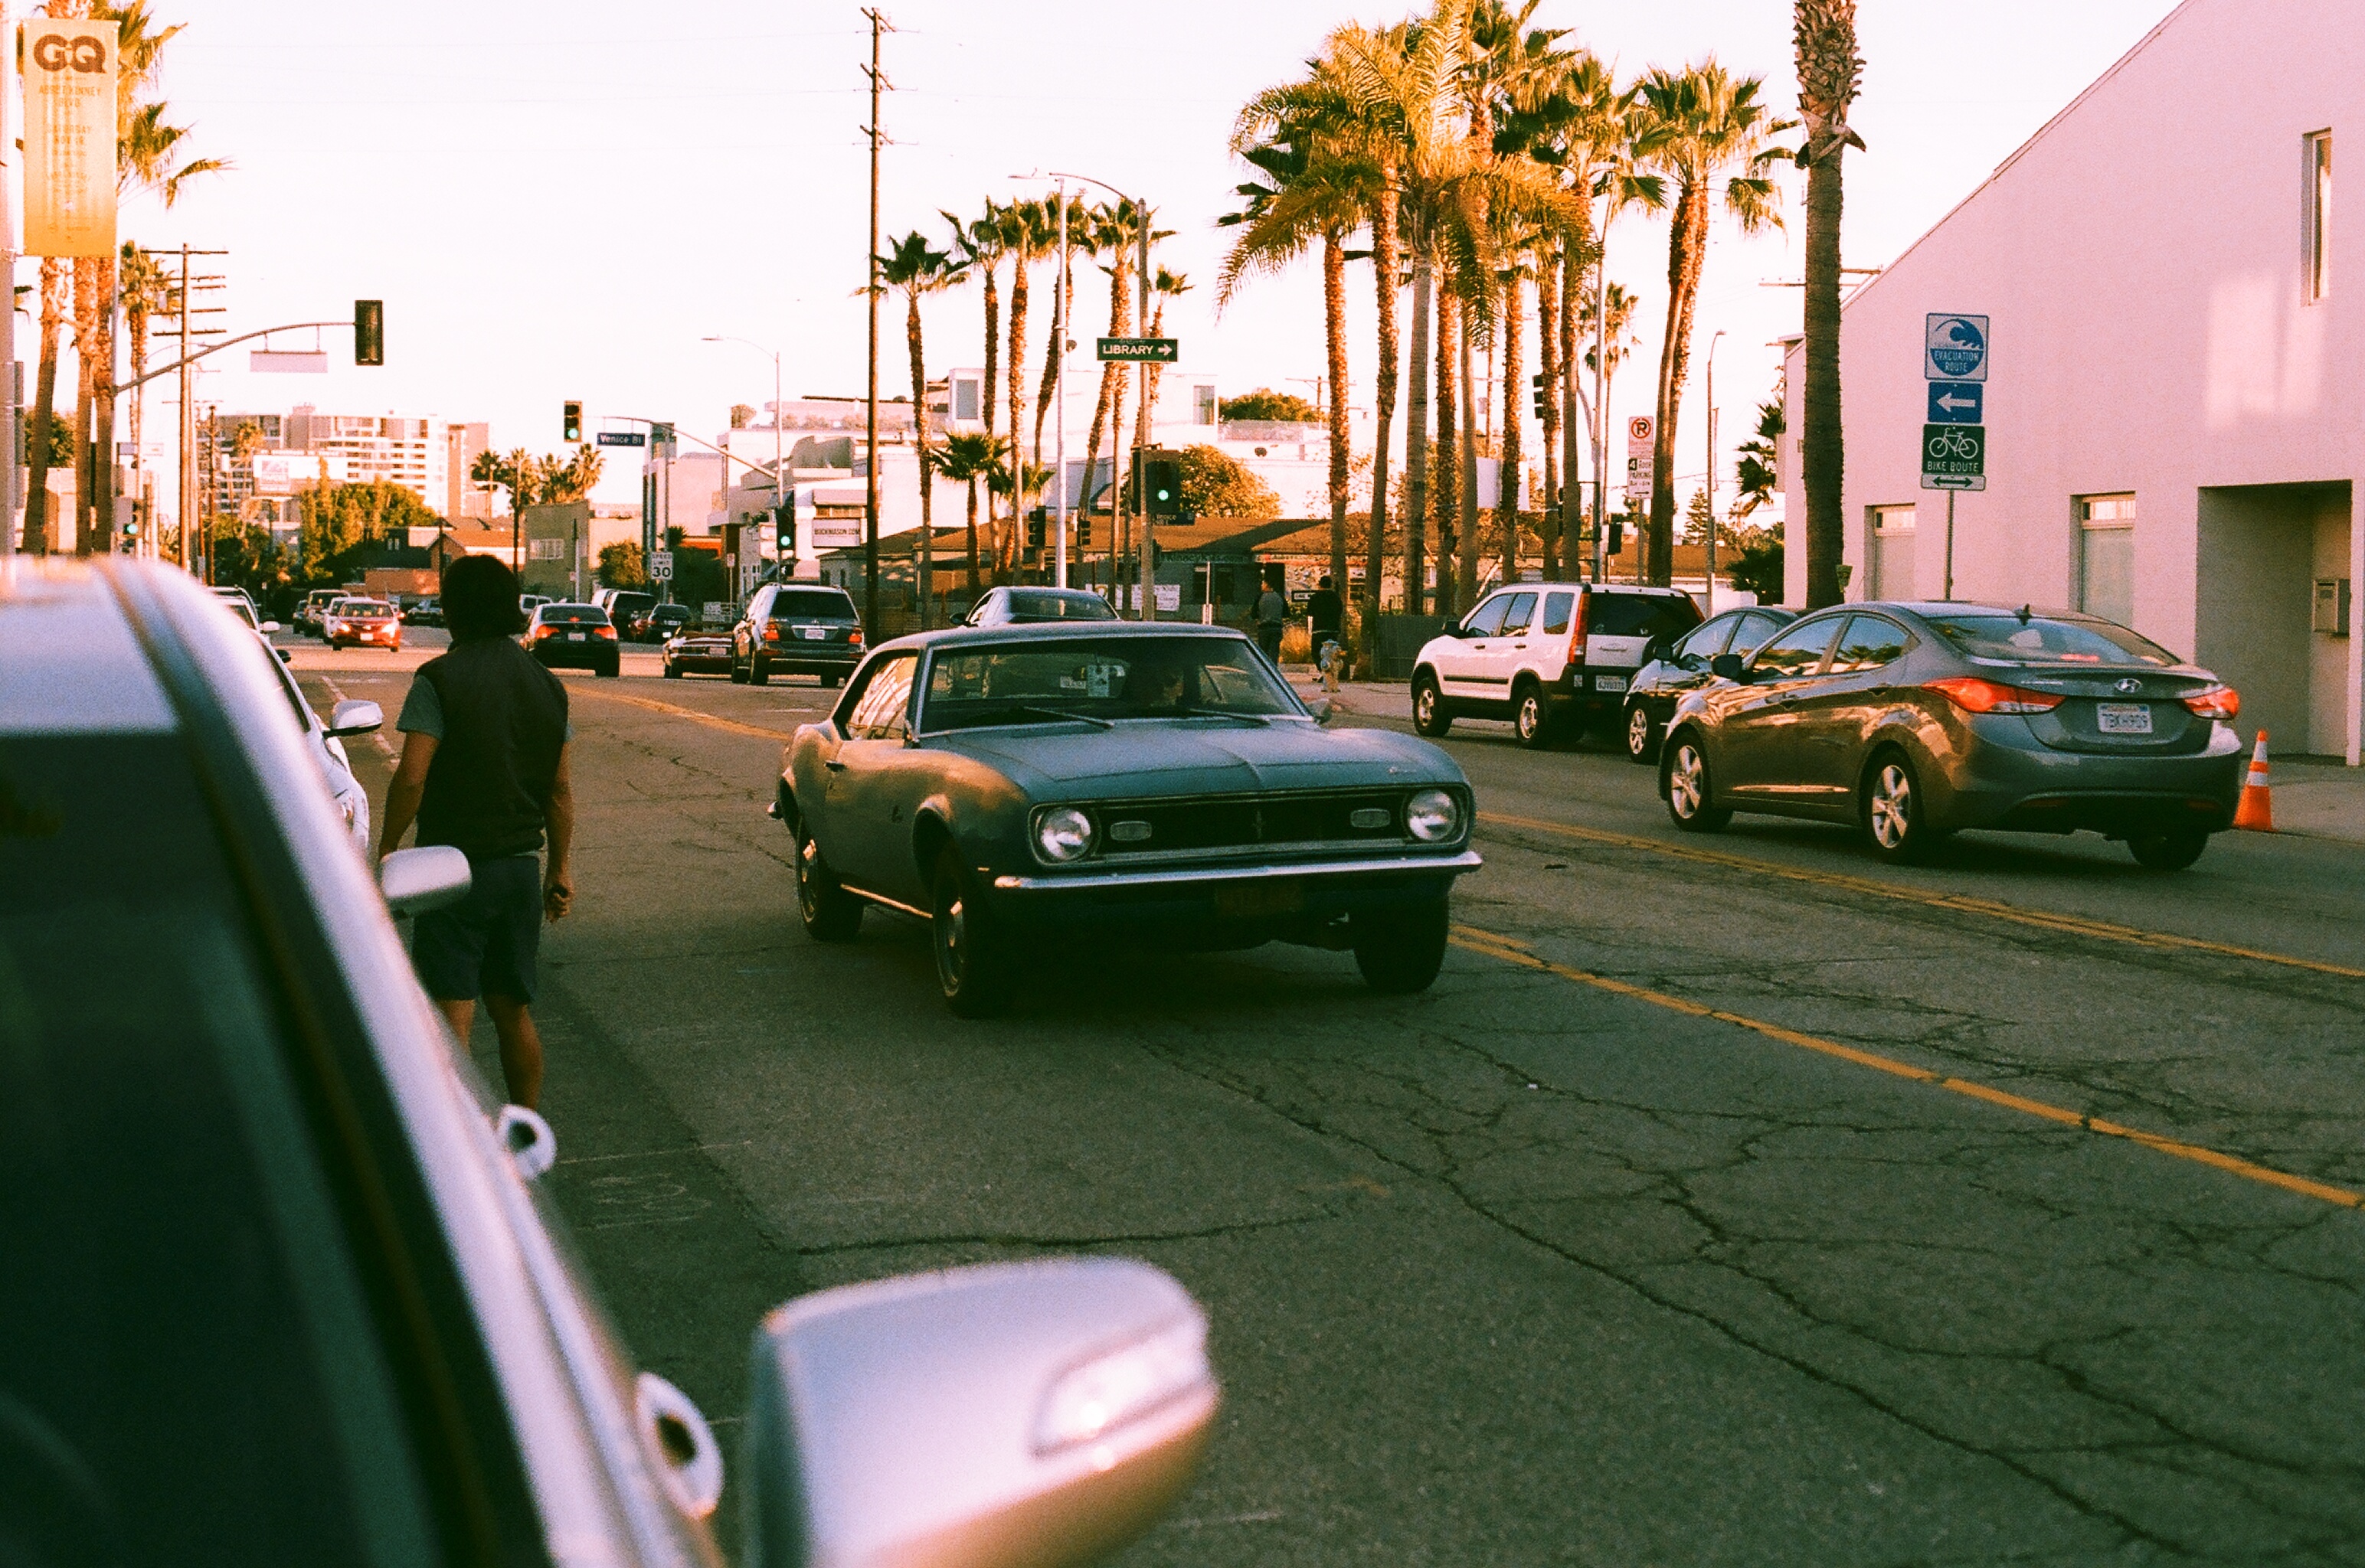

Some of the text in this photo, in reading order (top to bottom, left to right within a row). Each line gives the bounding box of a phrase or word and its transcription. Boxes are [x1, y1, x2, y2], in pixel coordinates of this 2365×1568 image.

[34, 34, 106, 74] GQ
[1102, 345, 1153, 354] LIBRARY
[1935, 351, 1979, 361] EVACUATION
[1945, 362, 1968, 372] ROUTE
[600, 435, 628, 443] Venice
[1927, 461, 1979, 472] BIKE ROUTE
[653, 567, 671, 577] 30
